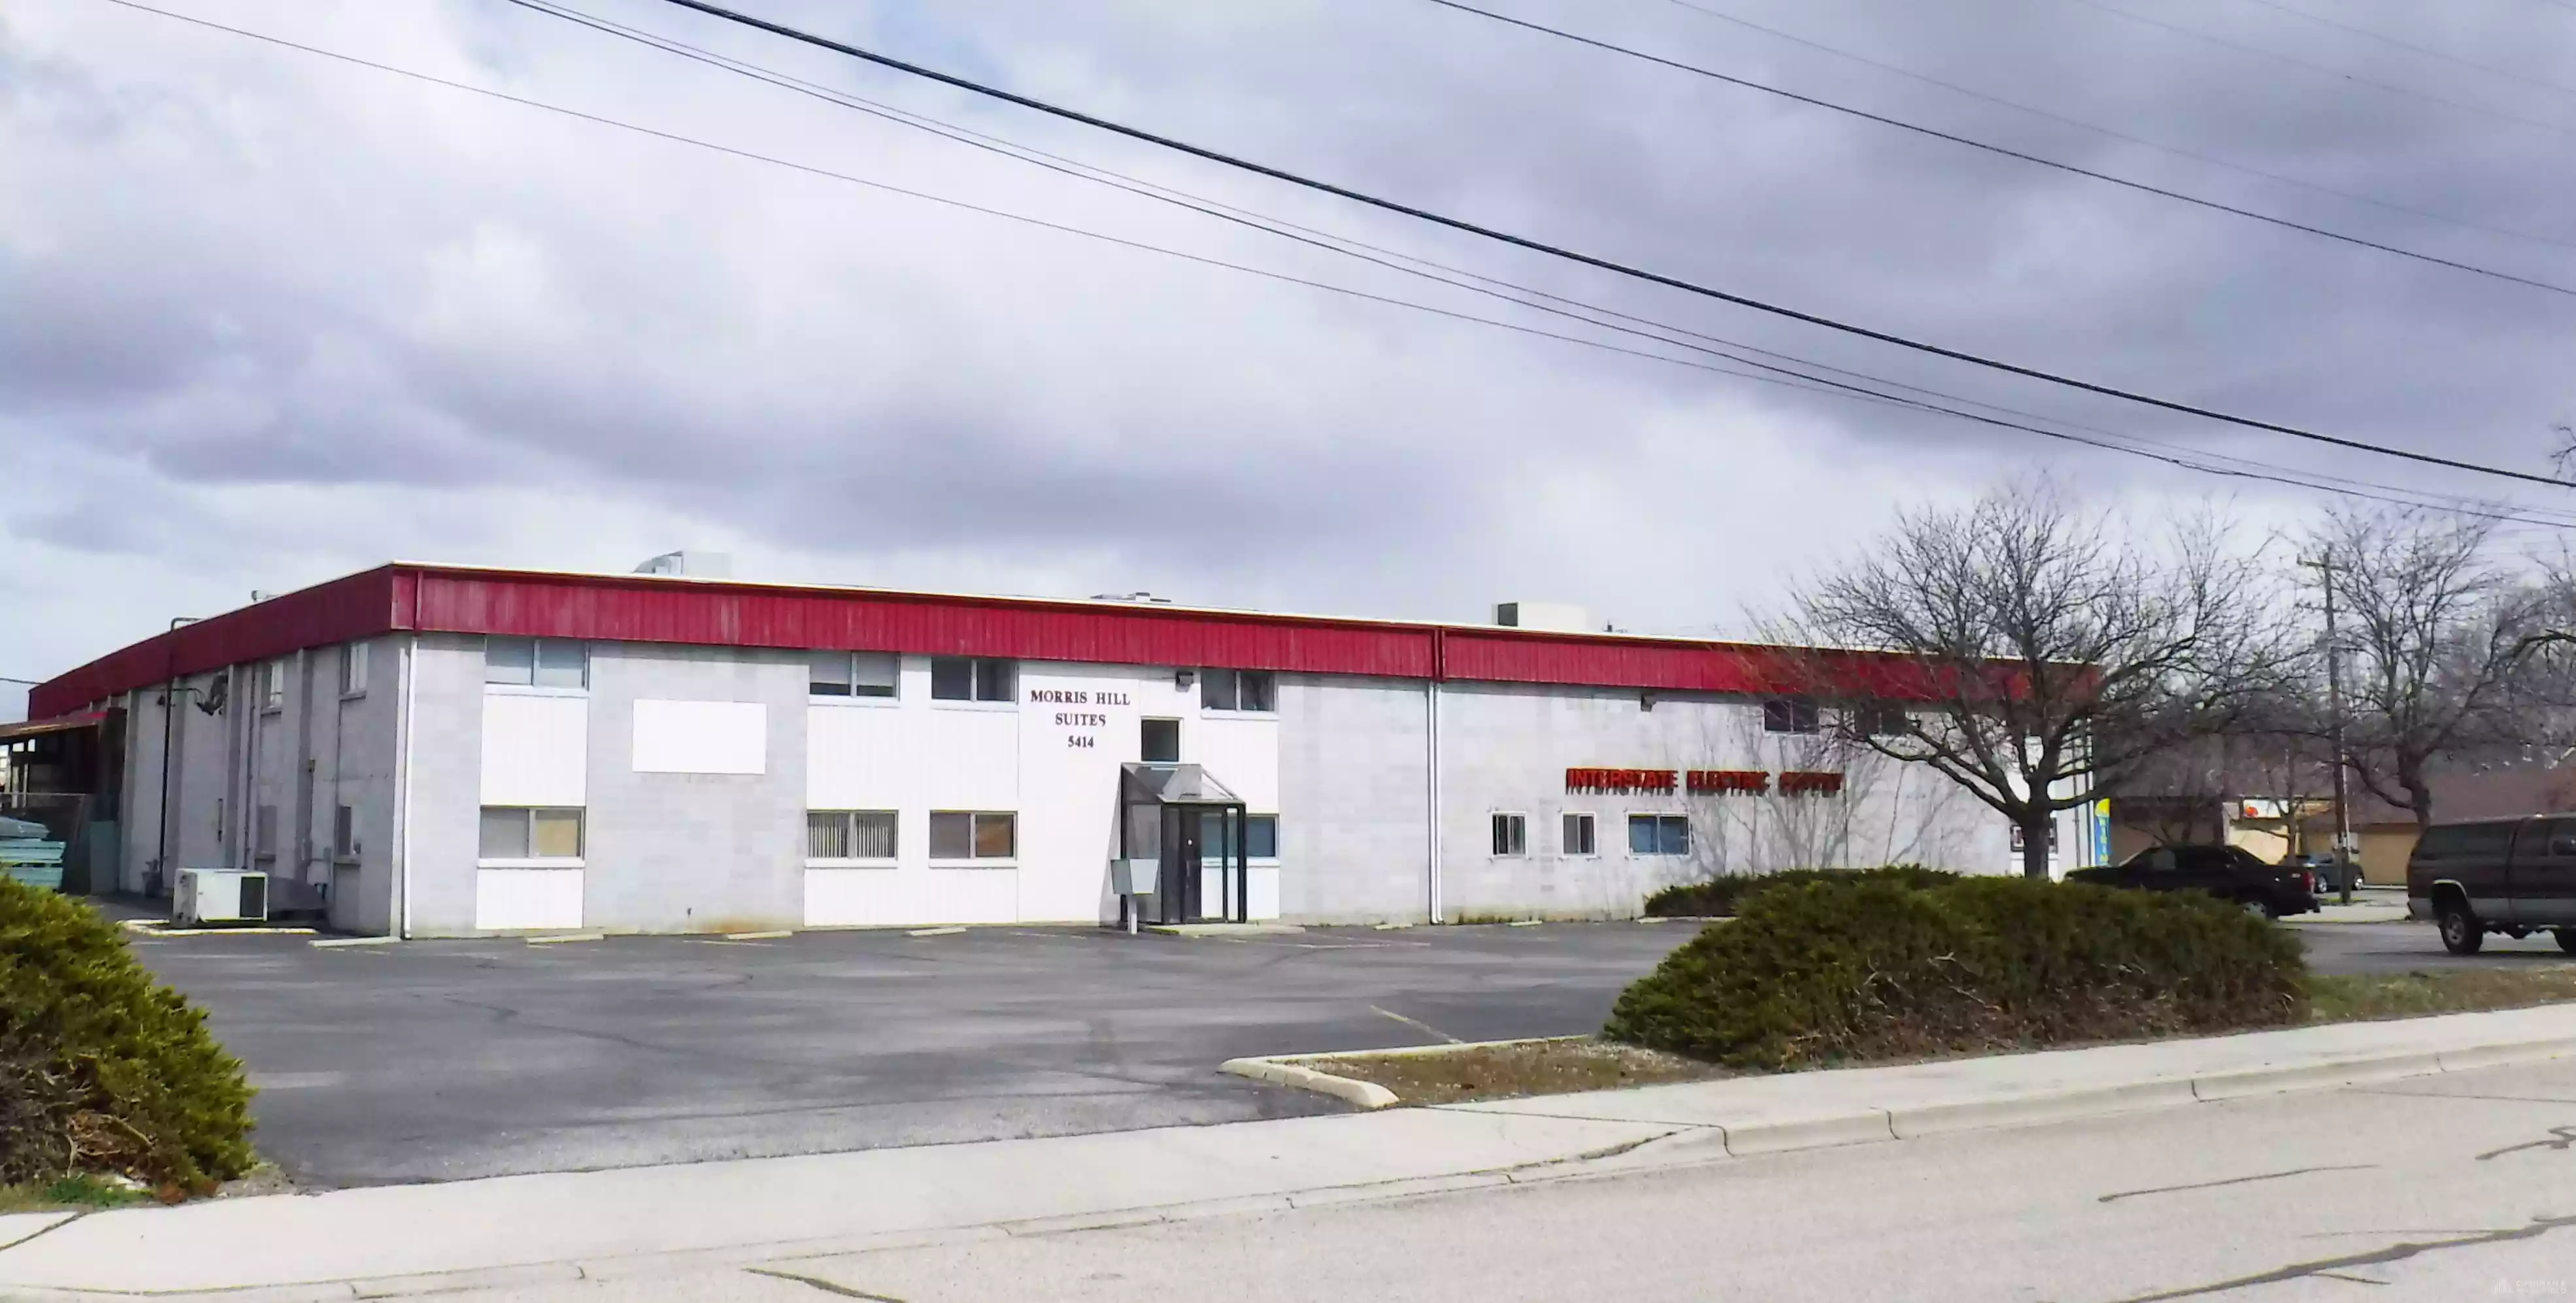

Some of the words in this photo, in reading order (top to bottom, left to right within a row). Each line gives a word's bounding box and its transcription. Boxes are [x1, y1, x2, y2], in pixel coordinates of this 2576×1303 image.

[1030, 689, 1088, 704] MORRIS
[1096, 692, 1131, 706] HILL
[1055, 712, 1106, 727] SUITES
[1067, 735, 1094, 748] 5414
[1566, 768, 1679, 789] INTERSTATE
